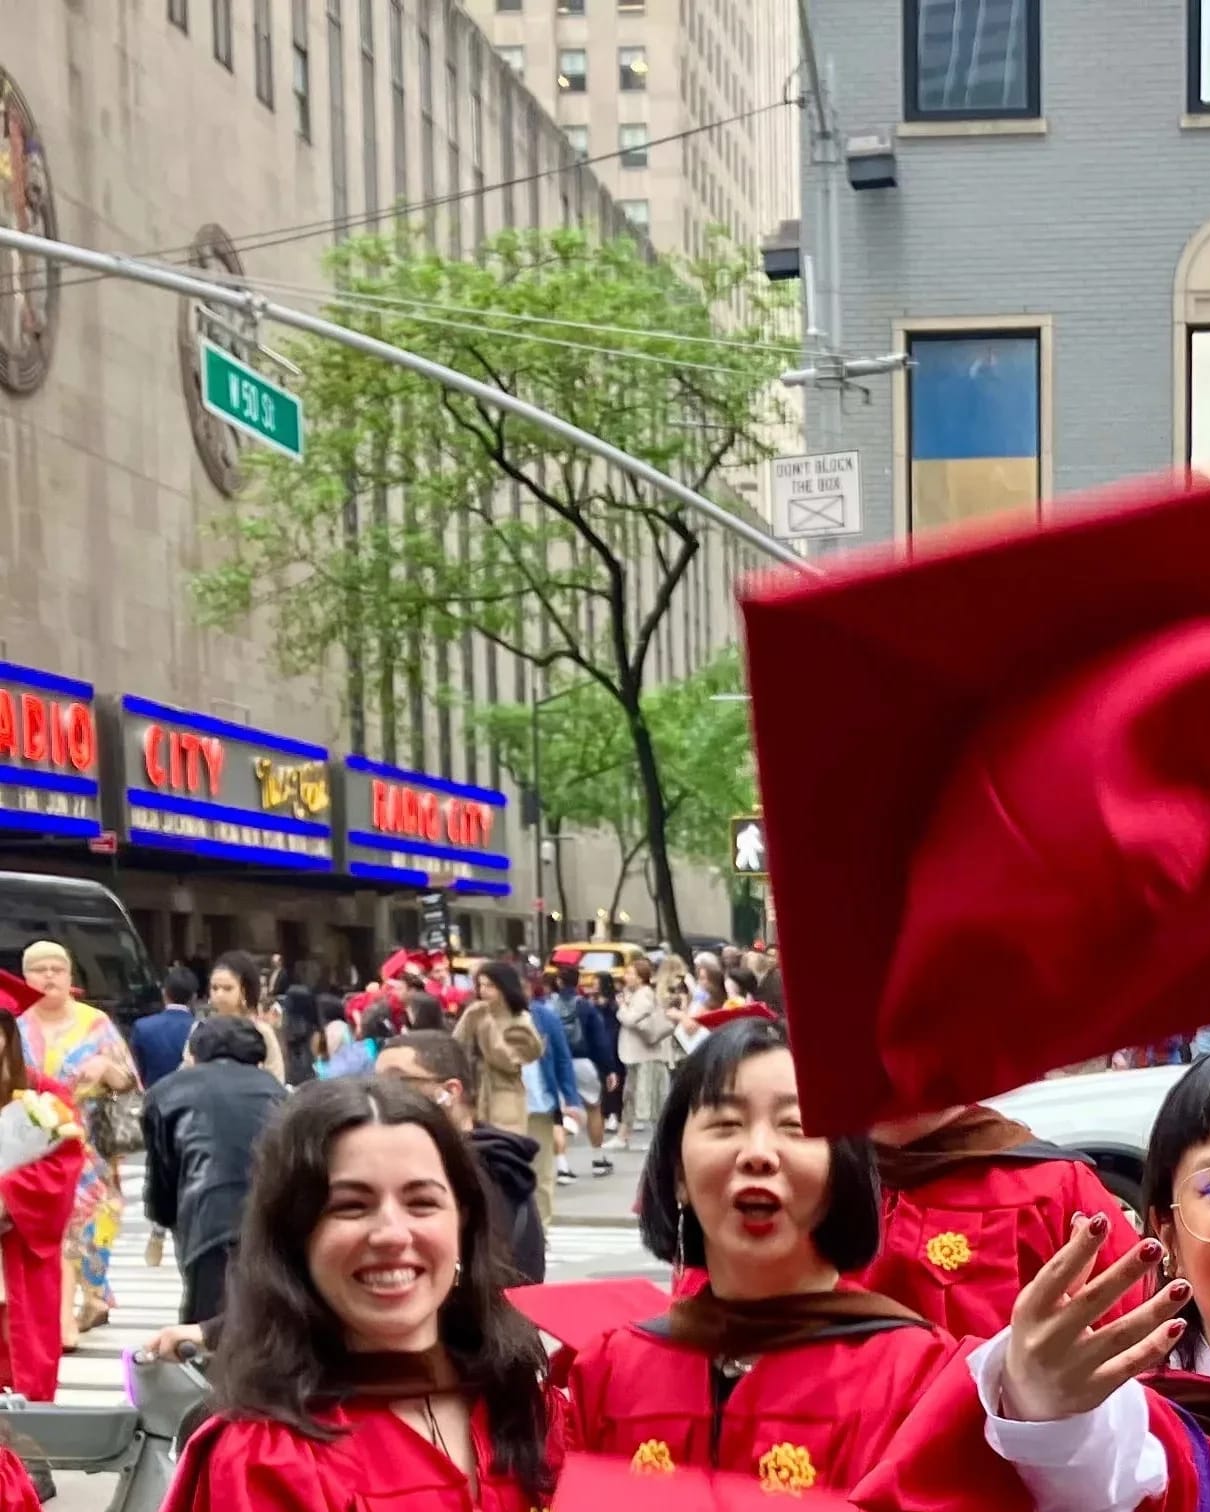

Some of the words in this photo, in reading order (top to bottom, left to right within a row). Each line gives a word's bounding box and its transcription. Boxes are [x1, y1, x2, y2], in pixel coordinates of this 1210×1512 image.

[241, 379, 260, 422] 50
[792, 479, 814, 495] THE
[817, 476, 841, 493] BOX
[814, 457, 854, 475] BLOCK
[143, 723, 225, 797] CITY
[445, 796, 495, 850] CITY
